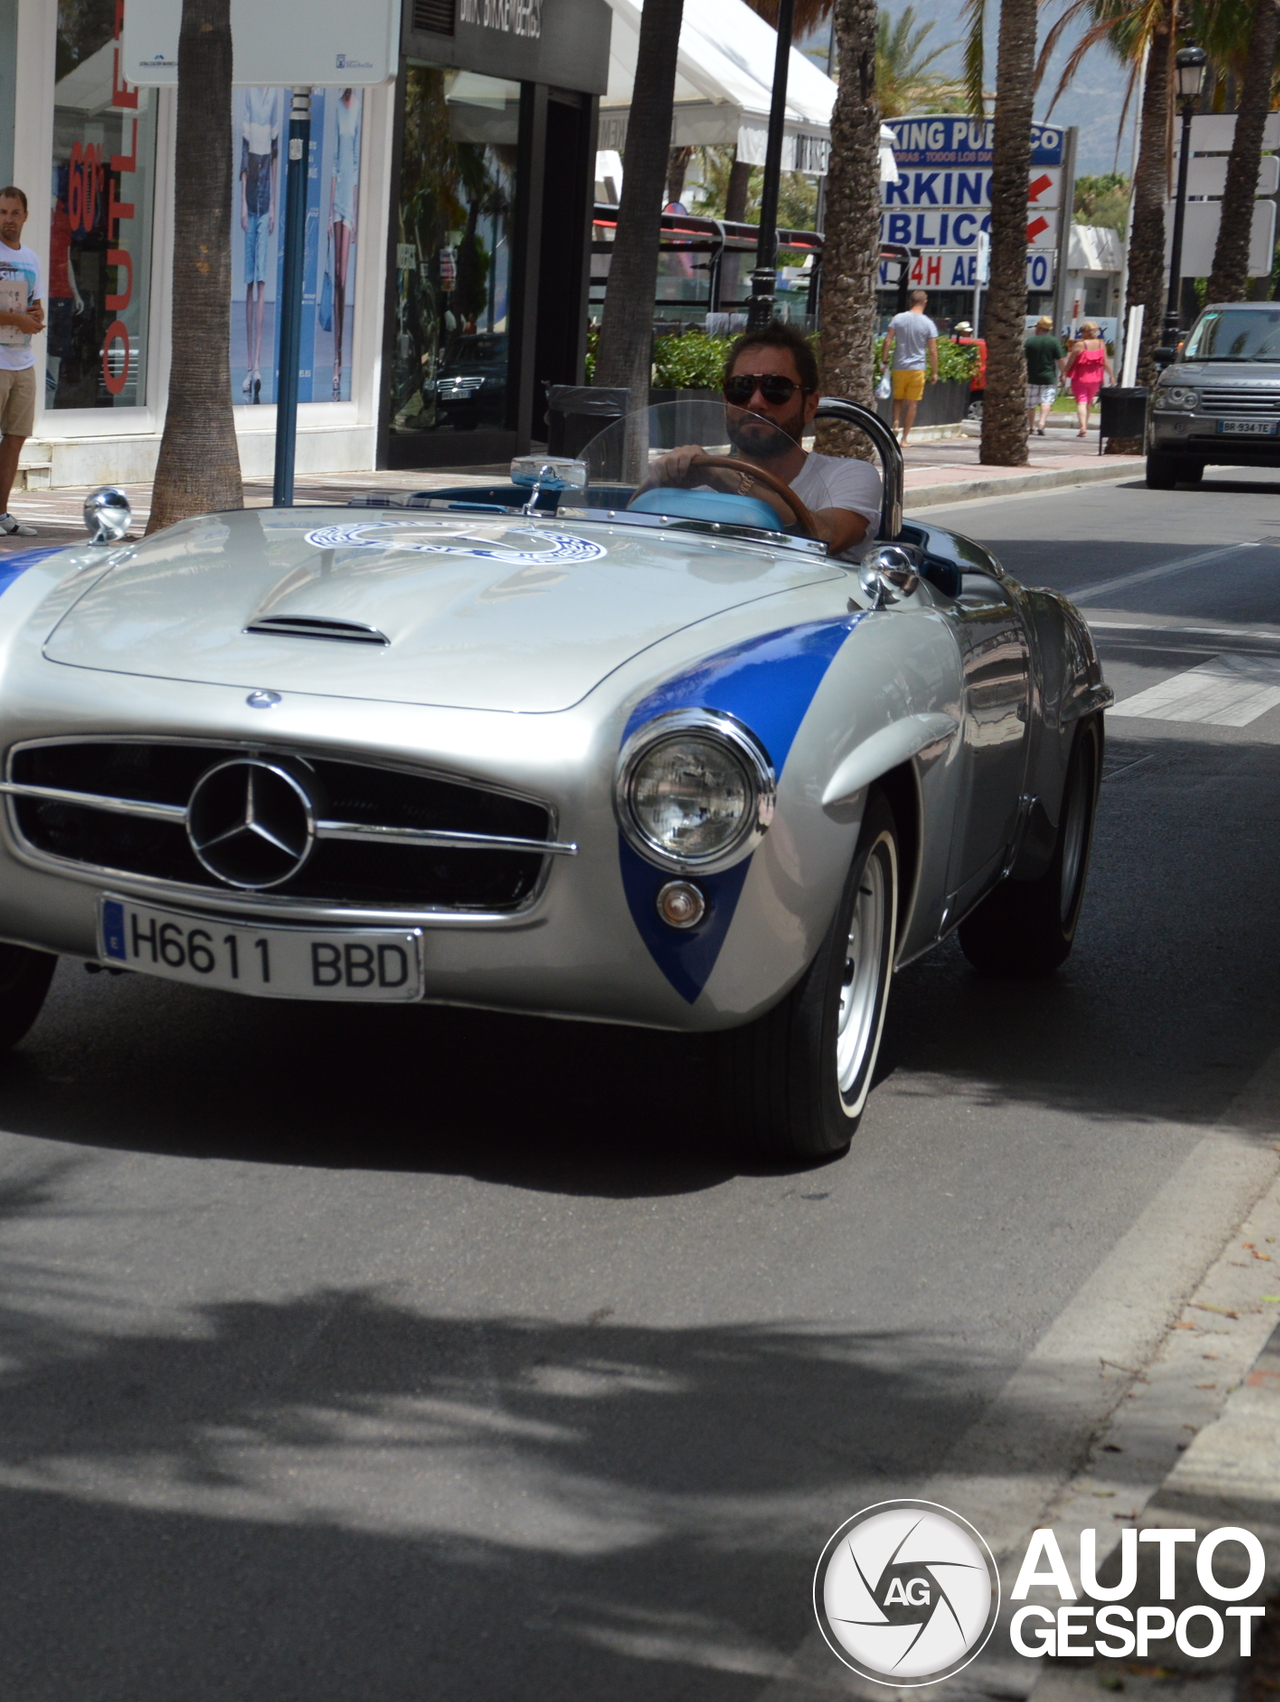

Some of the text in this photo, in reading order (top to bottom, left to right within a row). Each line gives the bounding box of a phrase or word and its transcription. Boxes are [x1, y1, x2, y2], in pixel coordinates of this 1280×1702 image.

[894, 152, 993, 162] ORAS TODOS LOS DIA
[68, 141, 105, 232] 60%
[910, 256, 942, 286] 4H
[131, 913, 270, 983] H6611
[311, 942, 409, 988] BBD
